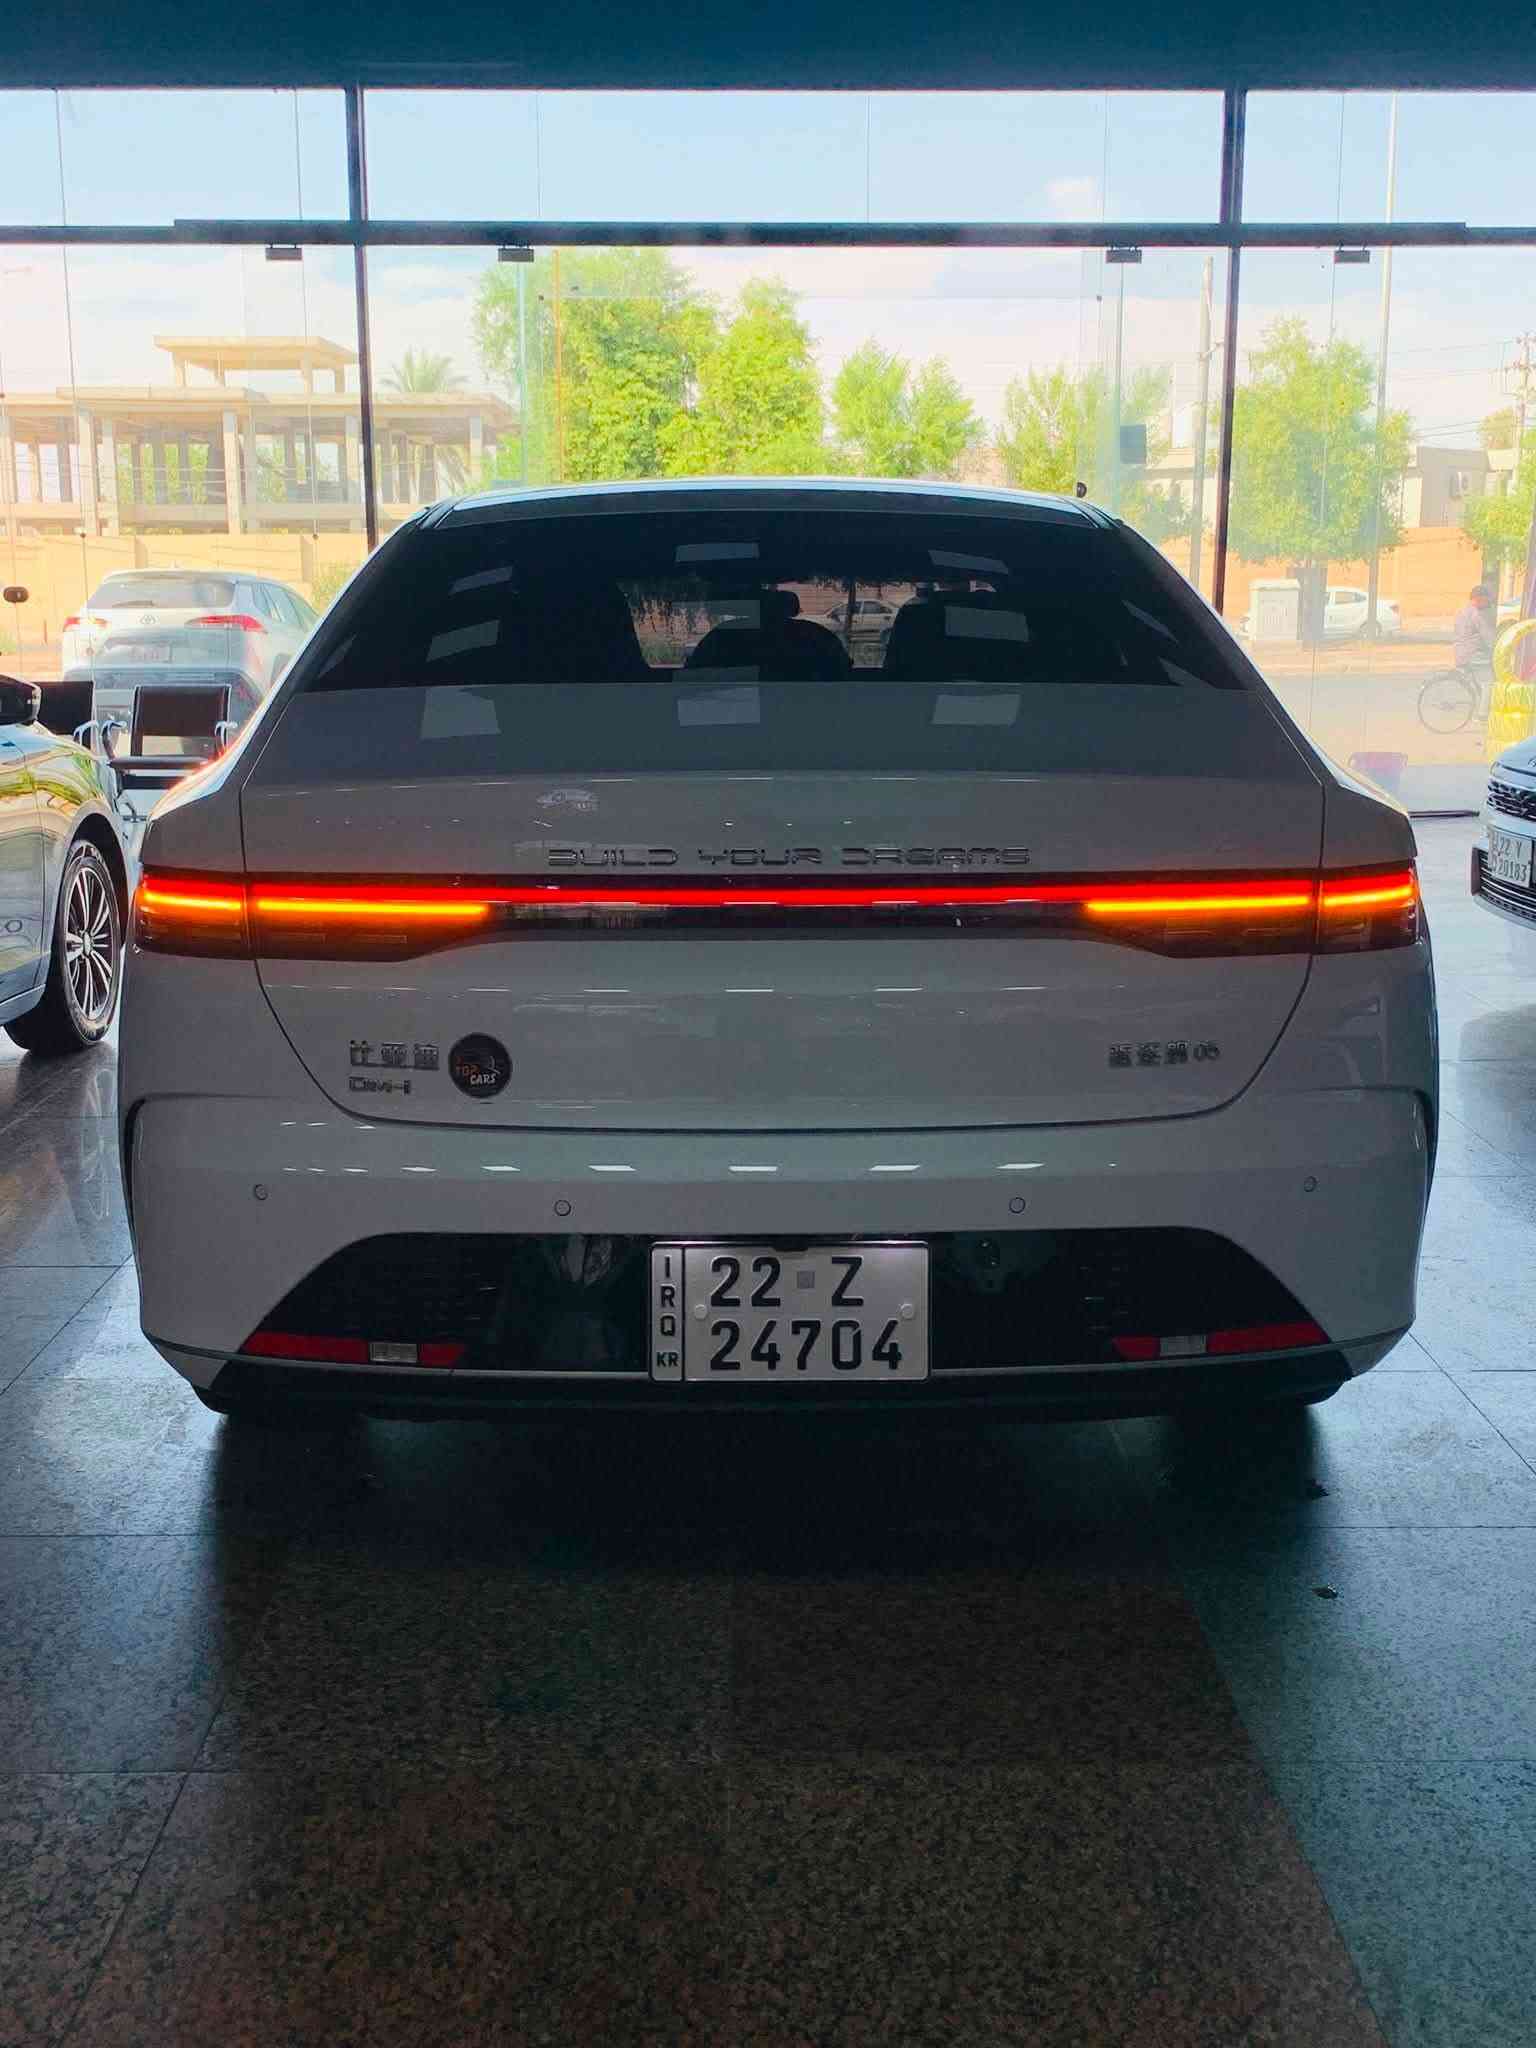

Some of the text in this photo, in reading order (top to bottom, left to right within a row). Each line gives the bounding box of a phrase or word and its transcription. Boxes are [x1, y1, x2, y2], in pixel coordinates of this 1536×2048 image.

[548, 848, 1032, 867] BUILD YOUR DREAMS
[470, 1073, 498, 1085] CARS
[659, 1255, 677, 1338] IRQ
[709, 1256, 864, 1308] 22 Z
[656, 1351, 679, 1368] KR
[709, 1319, 903, 1371] 24704
